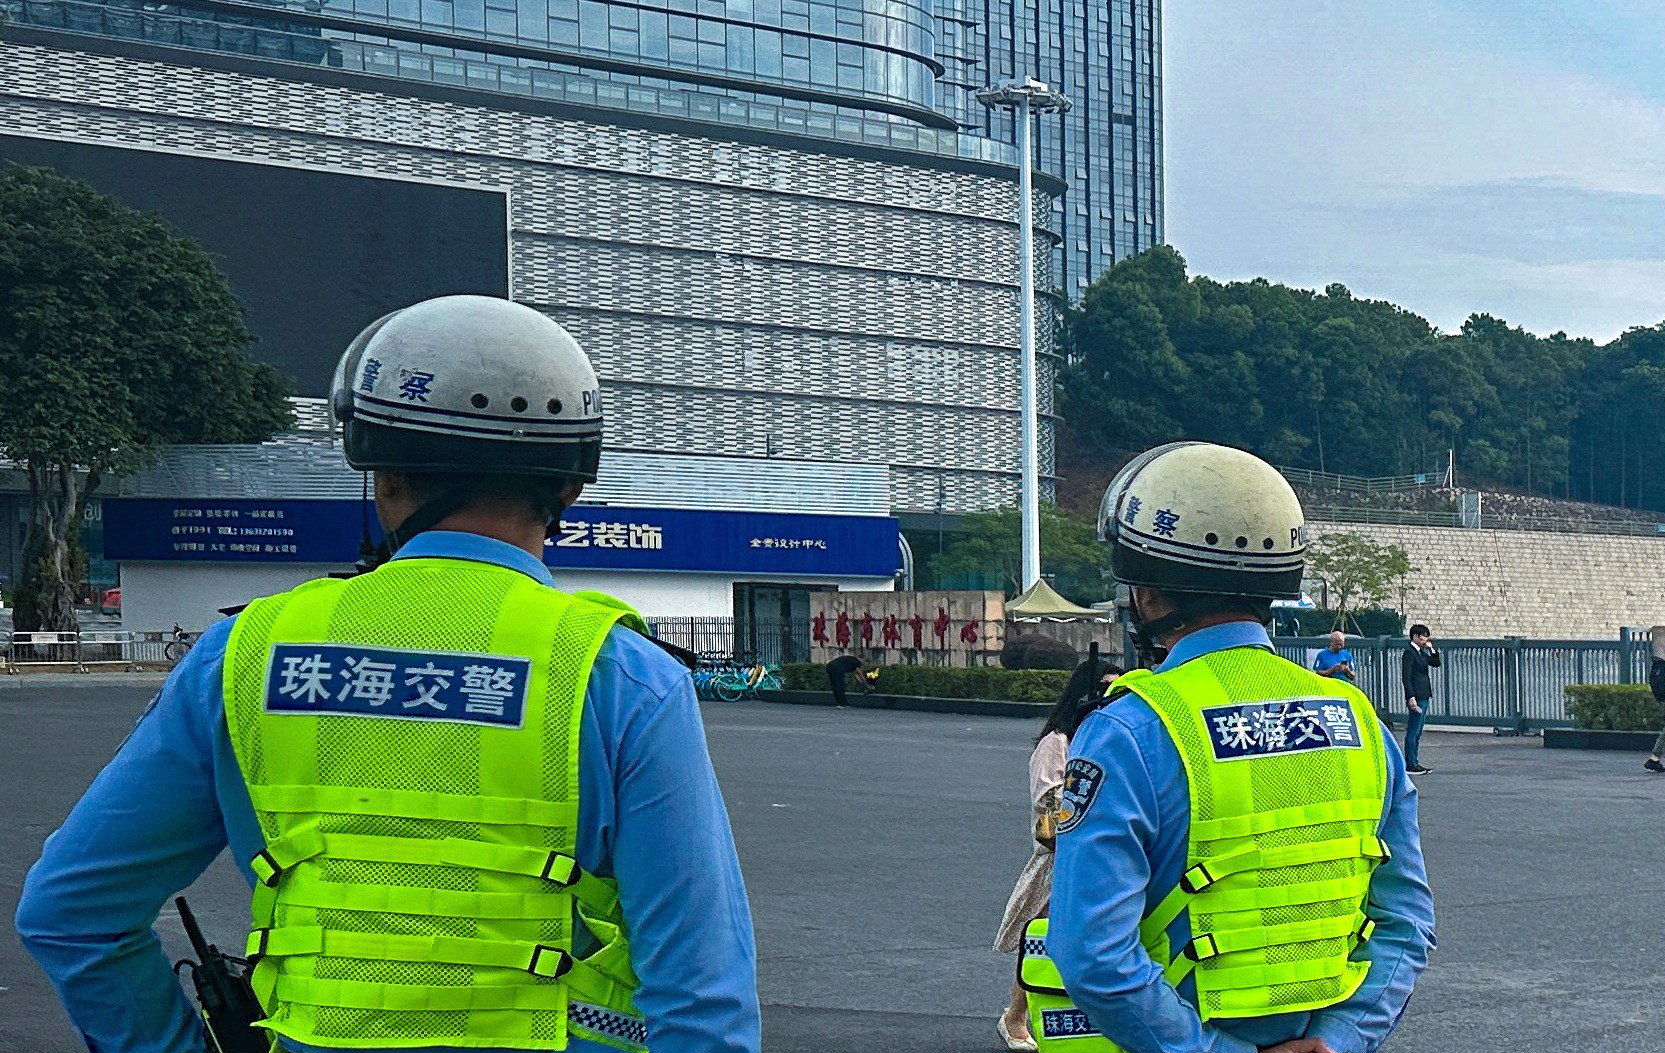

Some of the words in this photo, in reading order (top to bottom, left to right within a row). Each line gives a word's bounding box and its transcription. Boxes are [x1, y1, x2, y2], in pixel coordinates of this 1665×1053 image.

[361, 358, 435, 402] 警察
[543, 520, 662, 549] 艺装饰
[1124, 496, 1181, 538] 警察
[278, 653, 517, 716] 珠海交警
[1213, 704, 1353, 751] 珠海交警
[1045, 1013, 1099, 1032] 珠海交
